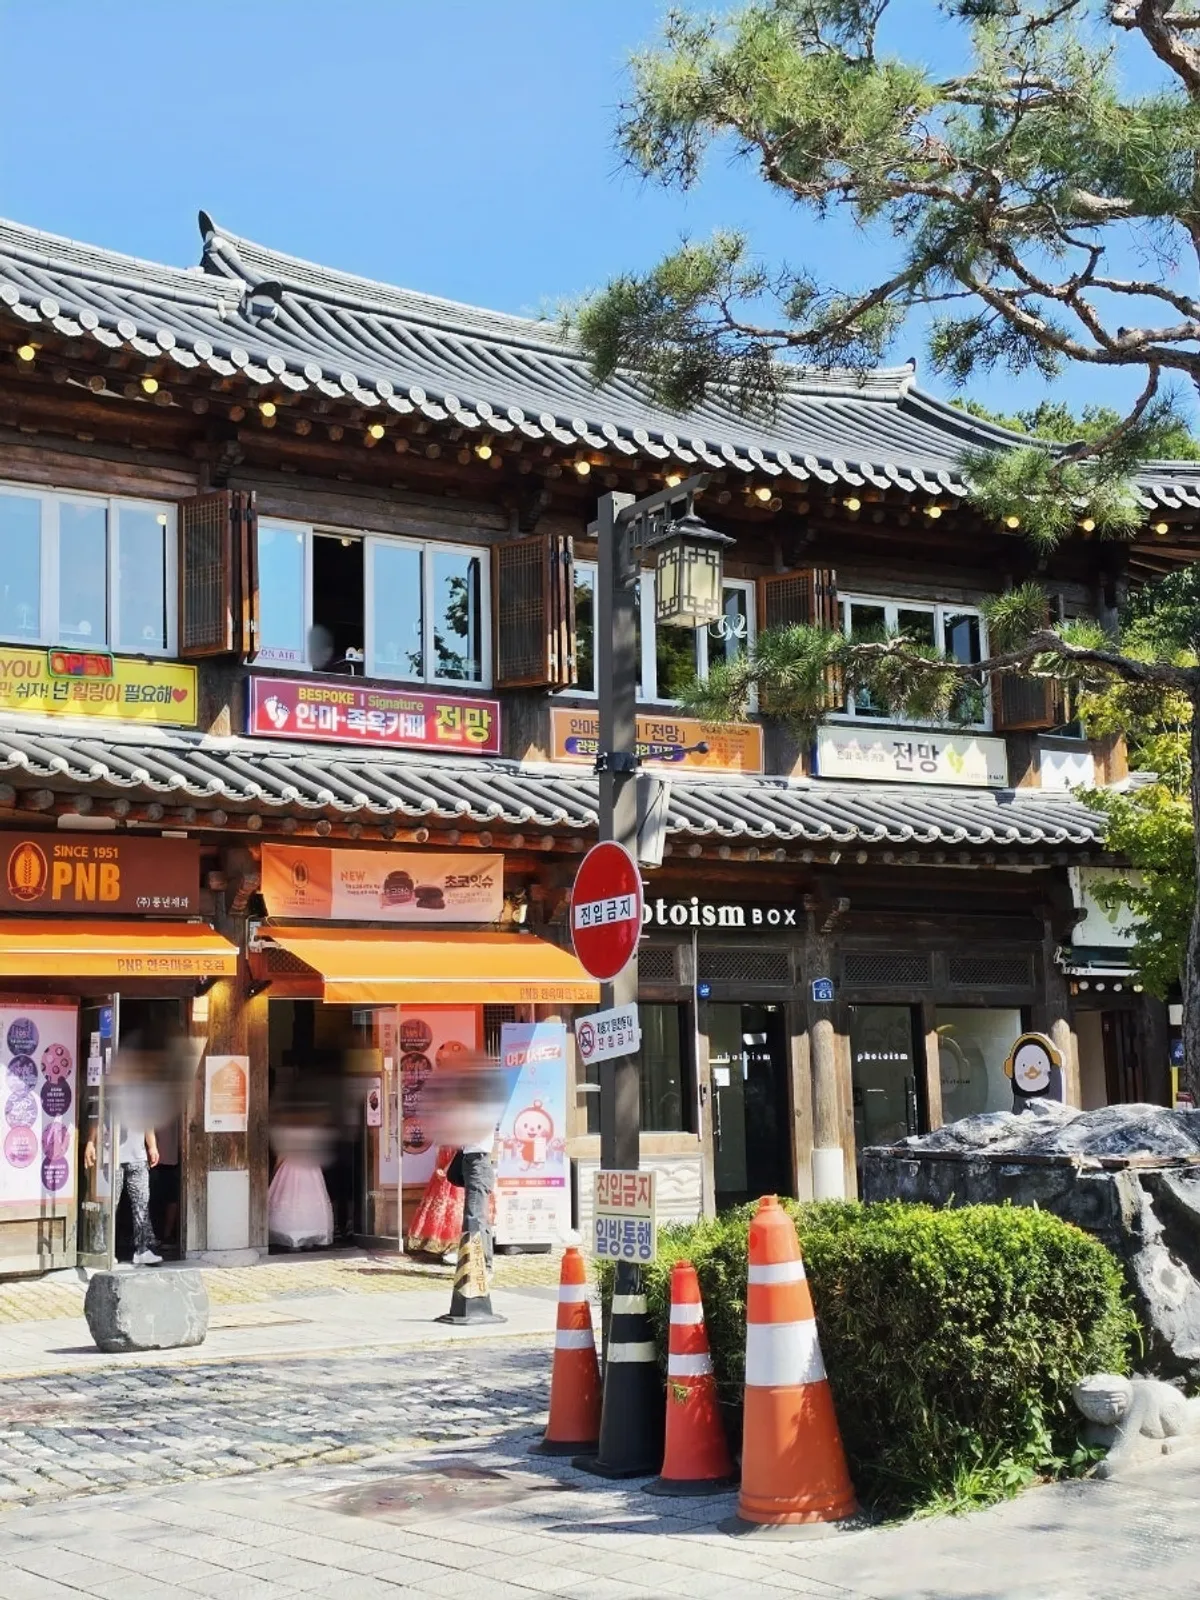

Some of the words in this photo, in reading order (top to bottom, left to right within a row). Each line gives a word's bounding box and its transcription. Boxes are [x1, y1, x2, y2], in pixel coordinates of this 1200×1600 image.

[51, 653, 112, 677] OPEN
[278, 651, 295, 661] AIR
[15, 682, 48, 699] 쉬자!
[53, 682, 69, 701] 넌
[72, 682, 121, 703] 힐링이
[124, 684, 173, 704] 필요해
[298, 687, 355, 706] BESPOKE
[367, 695, 425, 713] Signature
[435, 705, 492, 743] 전망
[892, 741, 940, 774] 전망
[53, 844, 88, 858] SINCE
[92, 845, 119, 859] 1951
[52, 861, 120, 902] PNB
[340, 870, 366, 882] NEW
[580, 896, 631, 926] 진입금지
[751, 908, 797, 926] BOX
[117, 958, 143, 972] PNB
[818, 989, 833, 999] 61
[857, 1051, 908, 1062] photoism
[597, 1173, 652, 1209] 진입금지
[595, 1218, 652, 1260] 일방통행
